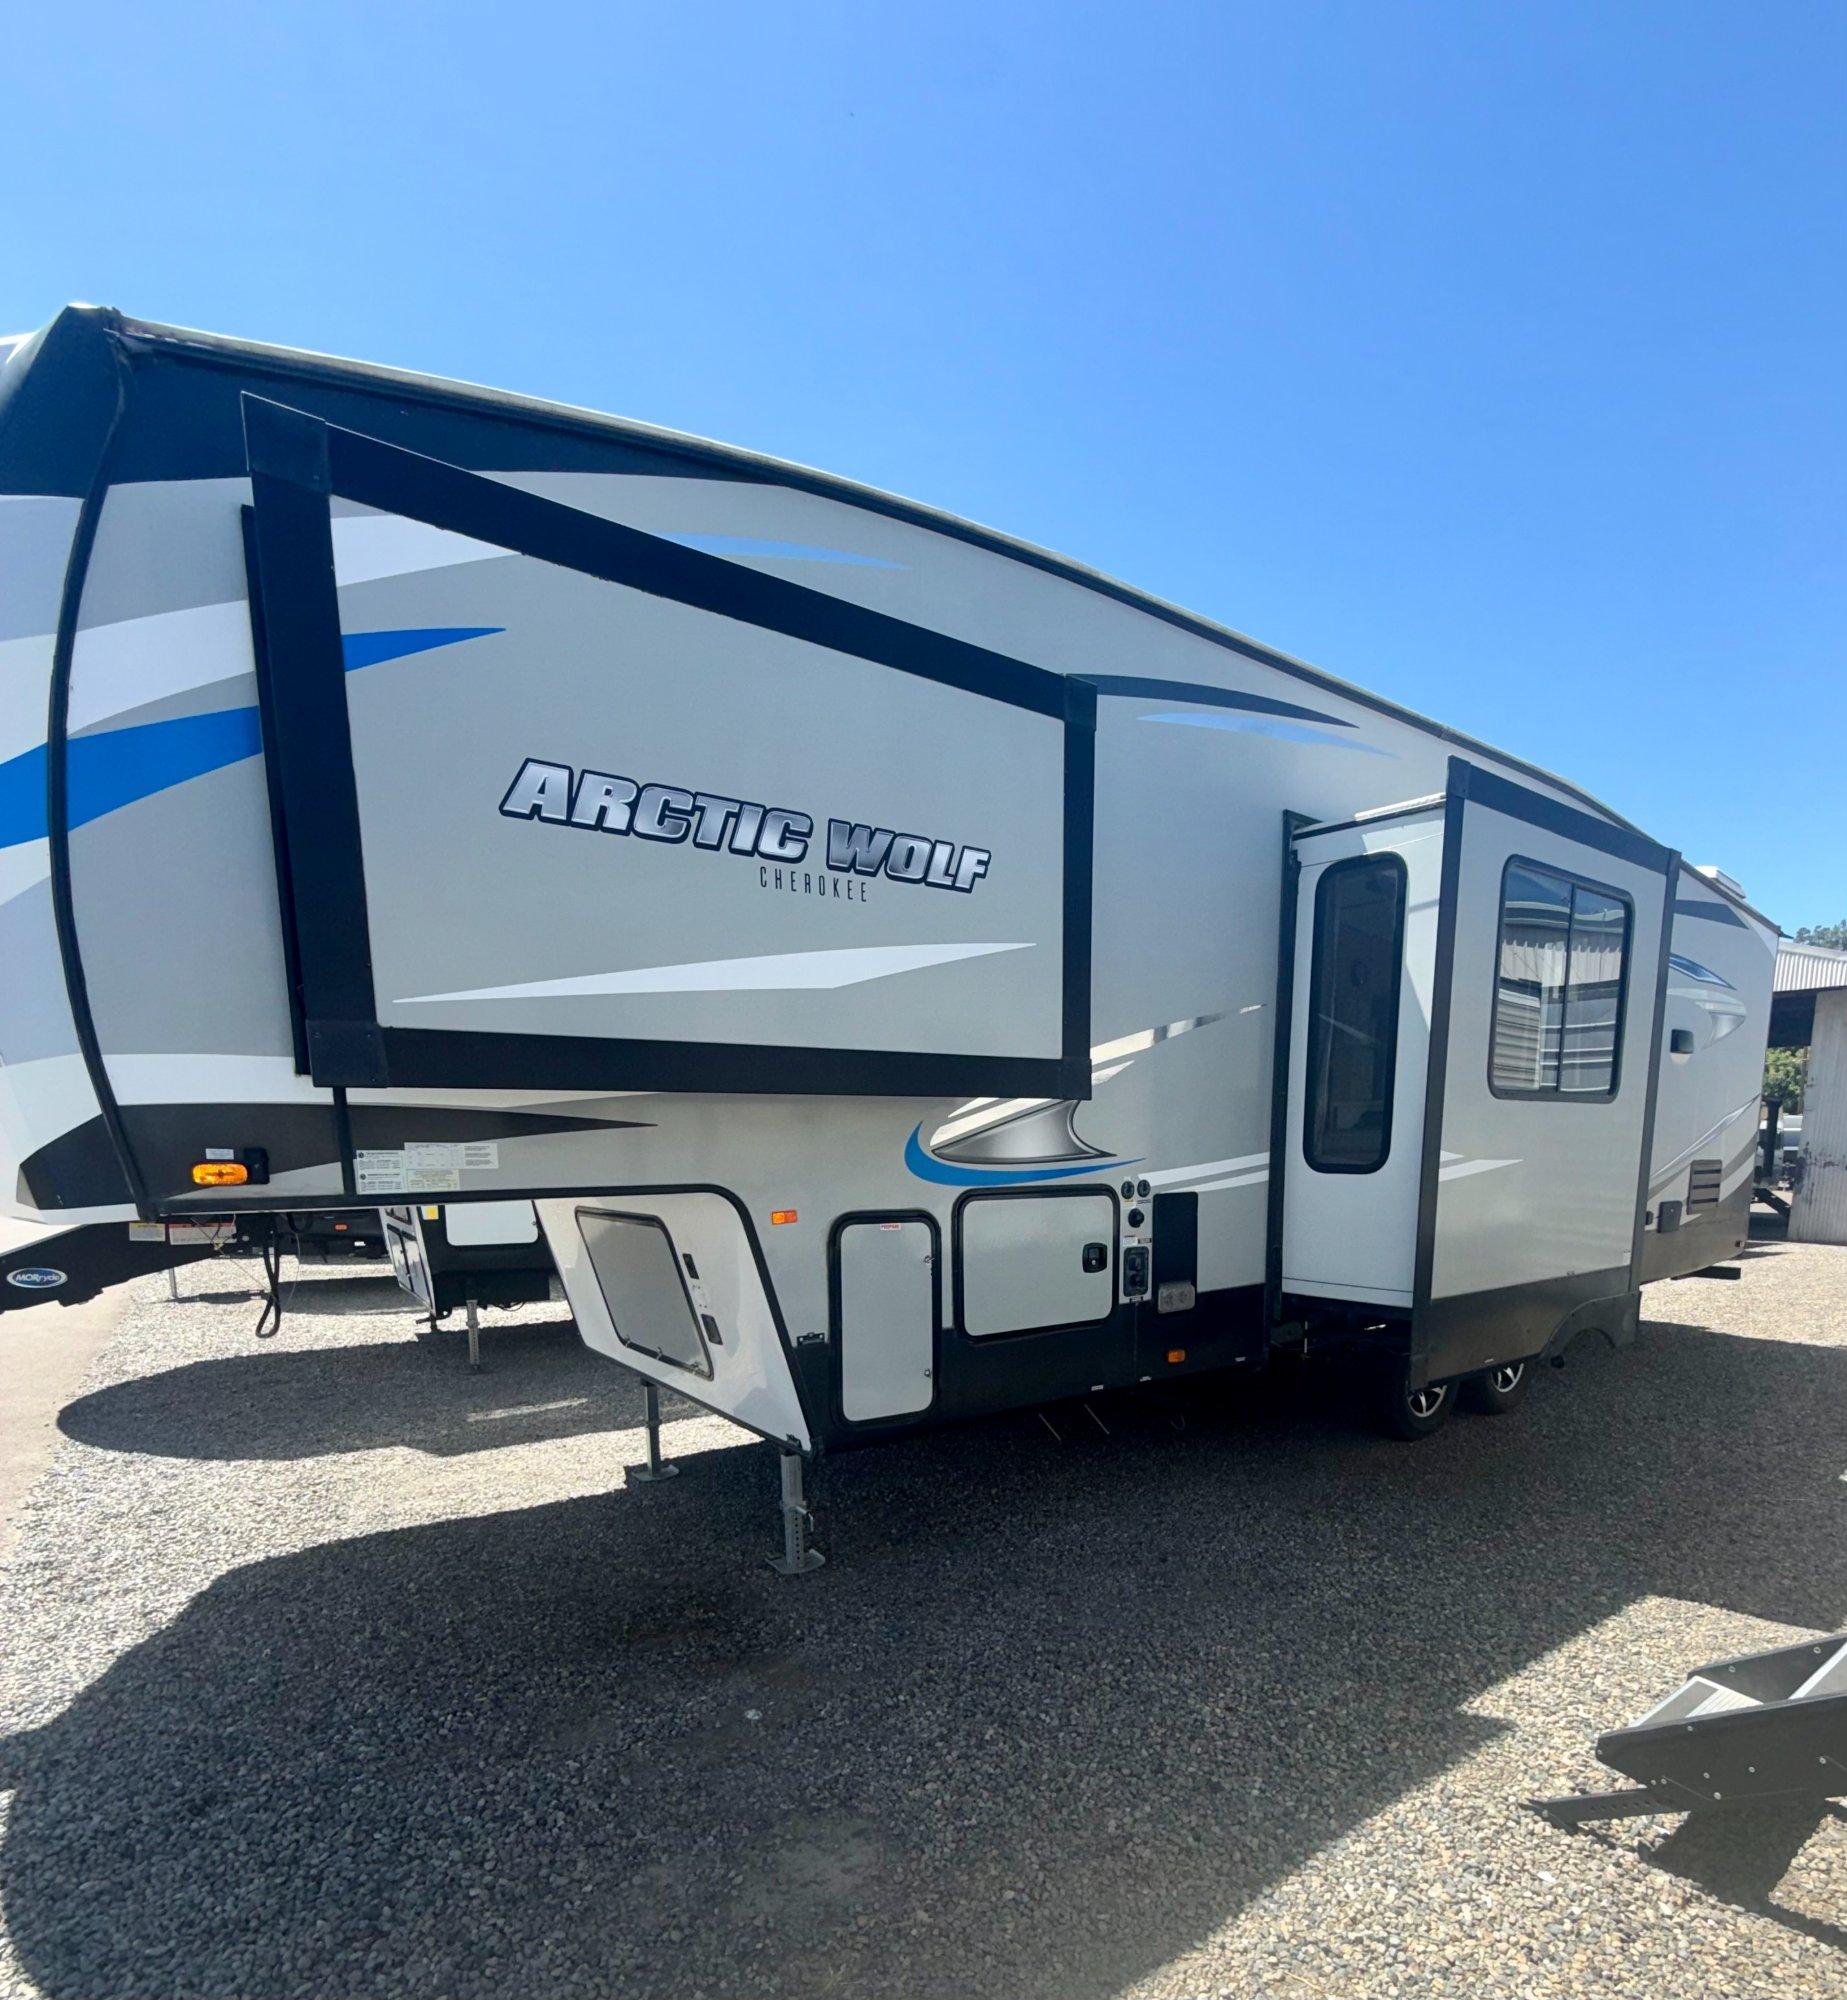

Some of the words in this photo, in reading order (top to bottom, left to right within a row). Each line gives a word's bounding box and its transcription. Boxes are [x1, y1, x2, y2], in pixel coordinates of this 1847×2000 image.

[499, 757, 814, 864] ARCTIC
[826, 818, 991, 893] WOLF
[760, 866, 867, 902] CHEROKEE
